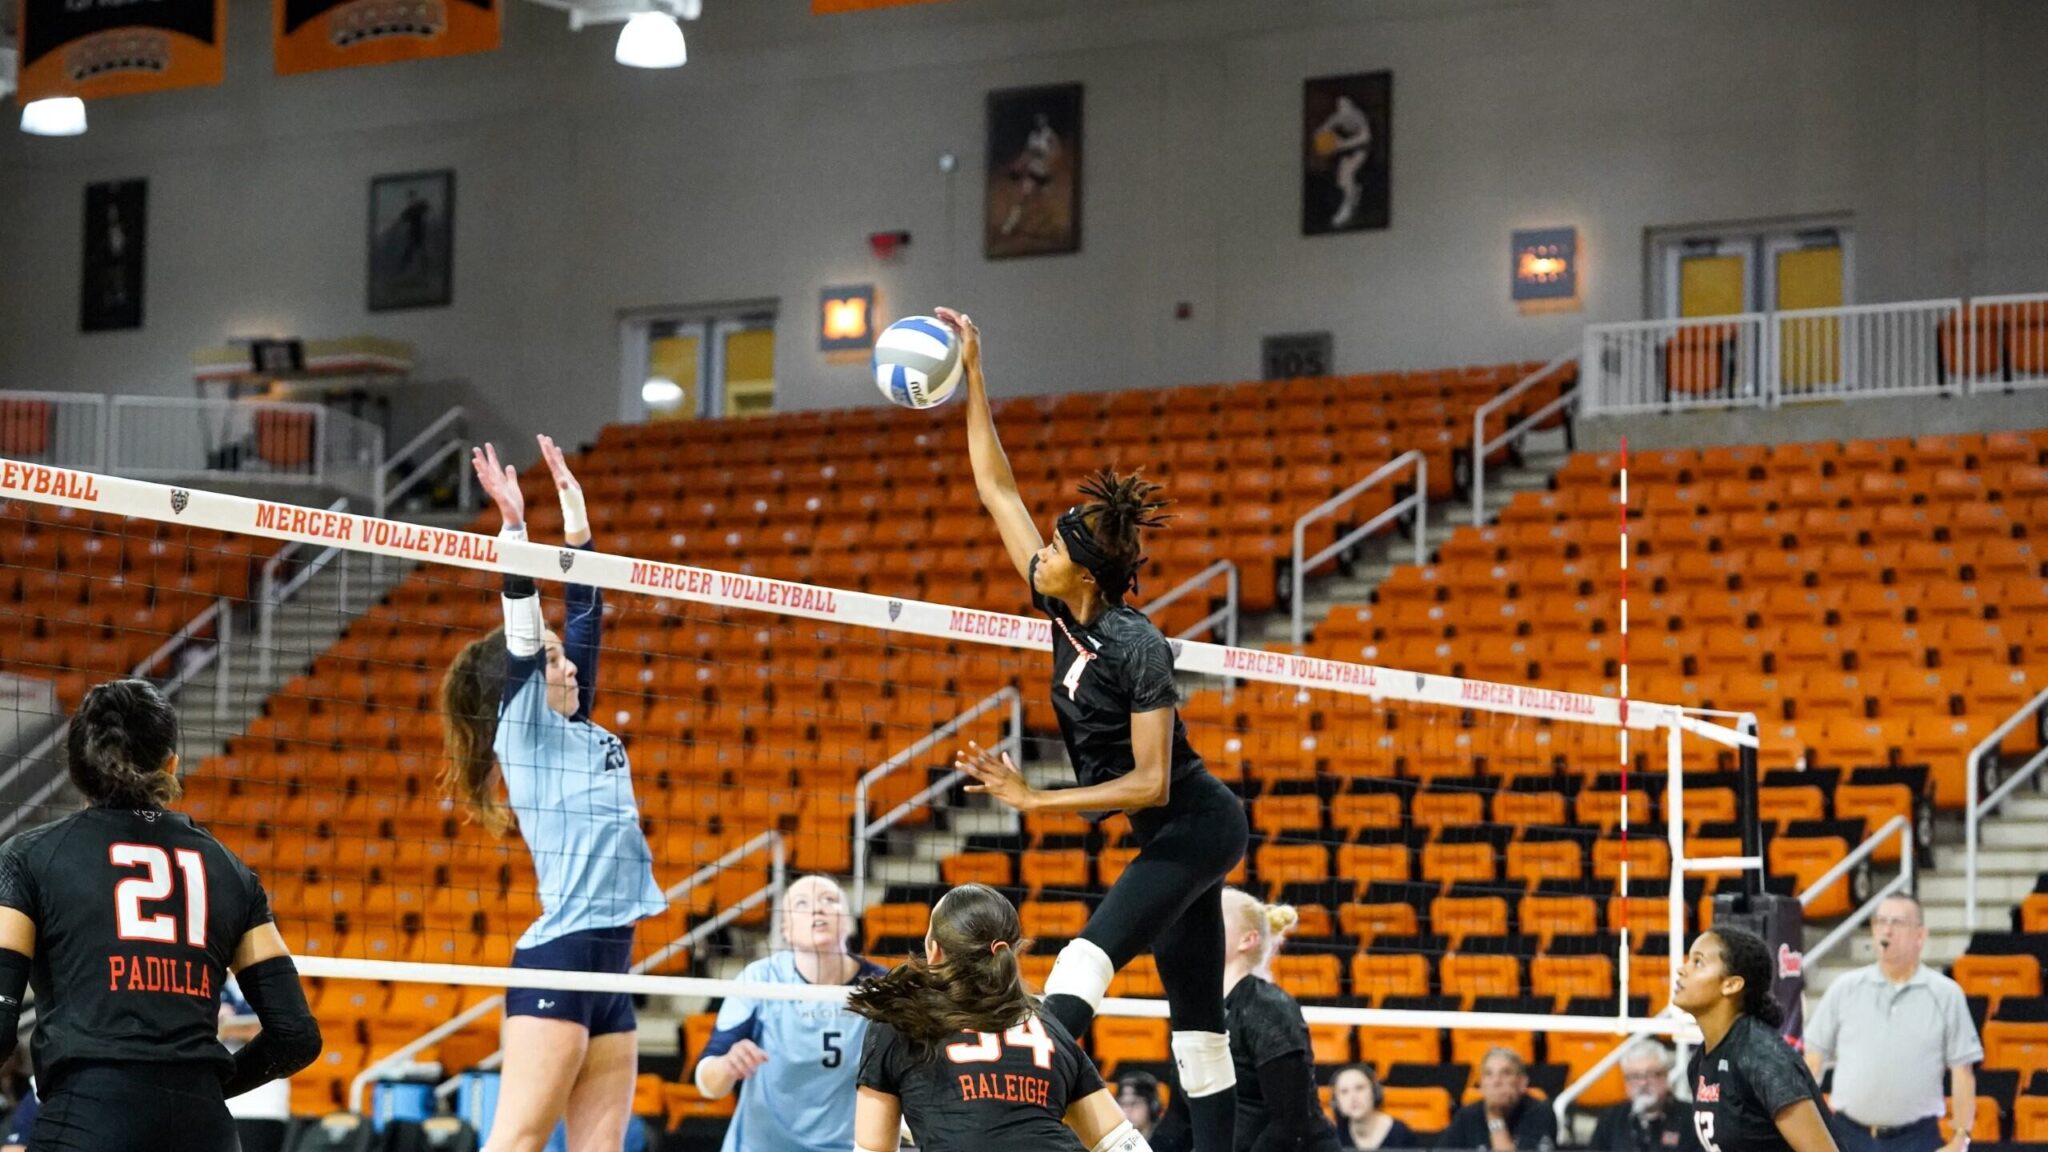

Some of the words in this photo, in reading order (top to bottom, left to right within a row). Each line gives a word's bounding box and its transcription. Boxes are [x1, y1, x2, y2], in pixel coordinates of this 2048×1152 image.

[0, 461, 99, 502] EYBALL
[255, 503, 353, 540] MERCER
[362, 518, 498, 563] VOLLEYBALL
[630, 561, 713, 595] MERCER
[720, 575, 837, 613] VOLLEYBALL
[949, 610, 1021, 639] MERCER
[1062, 653, 1089, 701] 4
[1223, 649, 1285, 674] MERCER
[1290, 657, 1376, 686] VOLLEYBALL
[1461, 682, 1514, 704] MERCER
[1519, 688, 1595, 714] VOLLEYBALL
[109, 842, 208, 949] 21
[109, 955, 212, 999] PADILLA
[822, 1032, 842, 1069] 5
[958, 1073, 1050, 1108] RALEIGH
